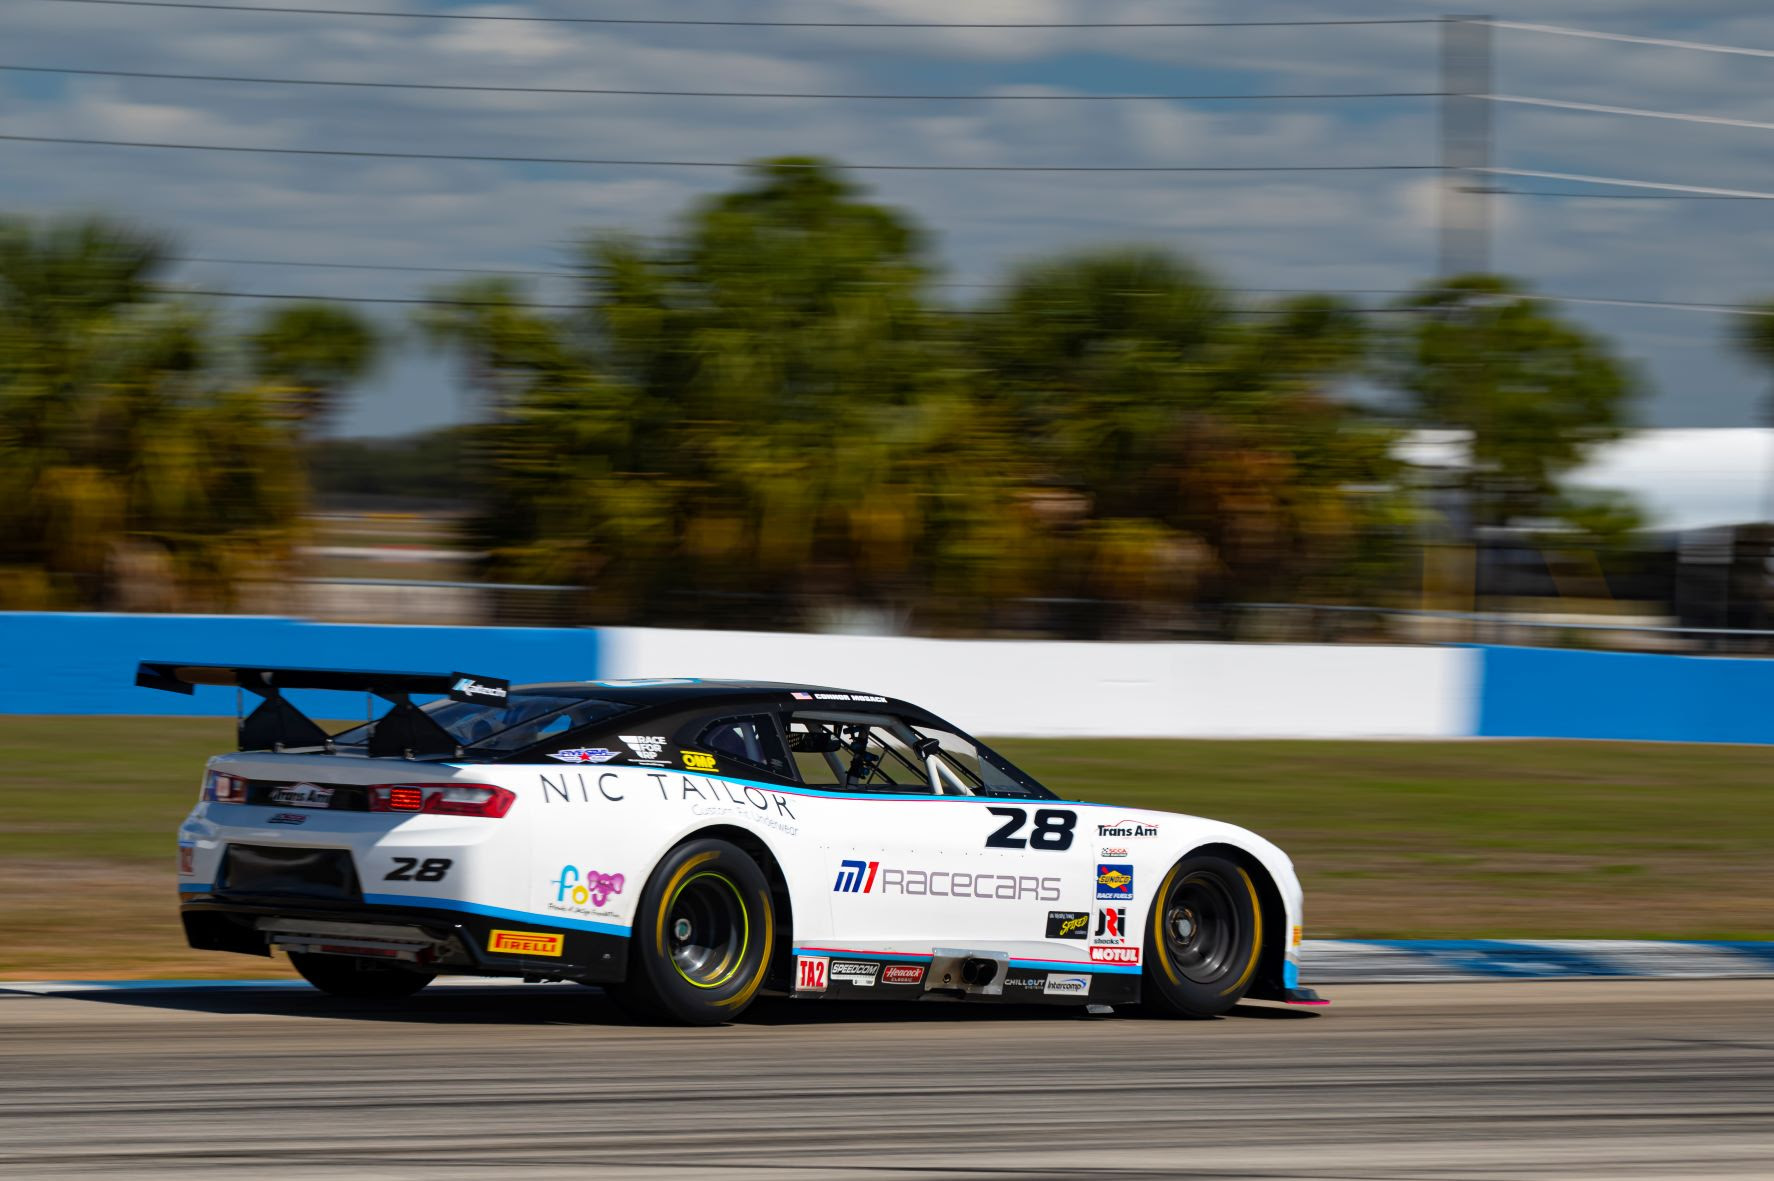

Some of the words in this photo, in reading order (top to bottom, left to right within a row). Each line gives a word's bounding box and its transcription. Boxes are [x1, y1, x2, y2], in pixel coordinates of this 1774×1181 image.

[814, 693, 850, 701] CONNOR
[638, 736, 667, 745] RACE
[640, 744, 663, 753] FOR
[682, 754, 716, 769] OMP
[539, 773, 624, 803] NIC
[647, 773, 796, 820] TAILOR
[985, 807, 1078, 851] 28
[1098, 825, 1132, 836] Trans
[1135, 825, 1158, 836] Am
[383, 857, 453, 882] 28
[1100, 875, 1130, 883] SUNOCO
[495, 932, 558, 953] PIRELLI
[1092, 948, 1138, 962] MOTUL
[800, 961, 825, 987] TA2
[832, 963, 878, 975] SPEEDCOM
[886, 967, 921, 978] Heacock
[1047, 980, 1082, 992] Intercomp
